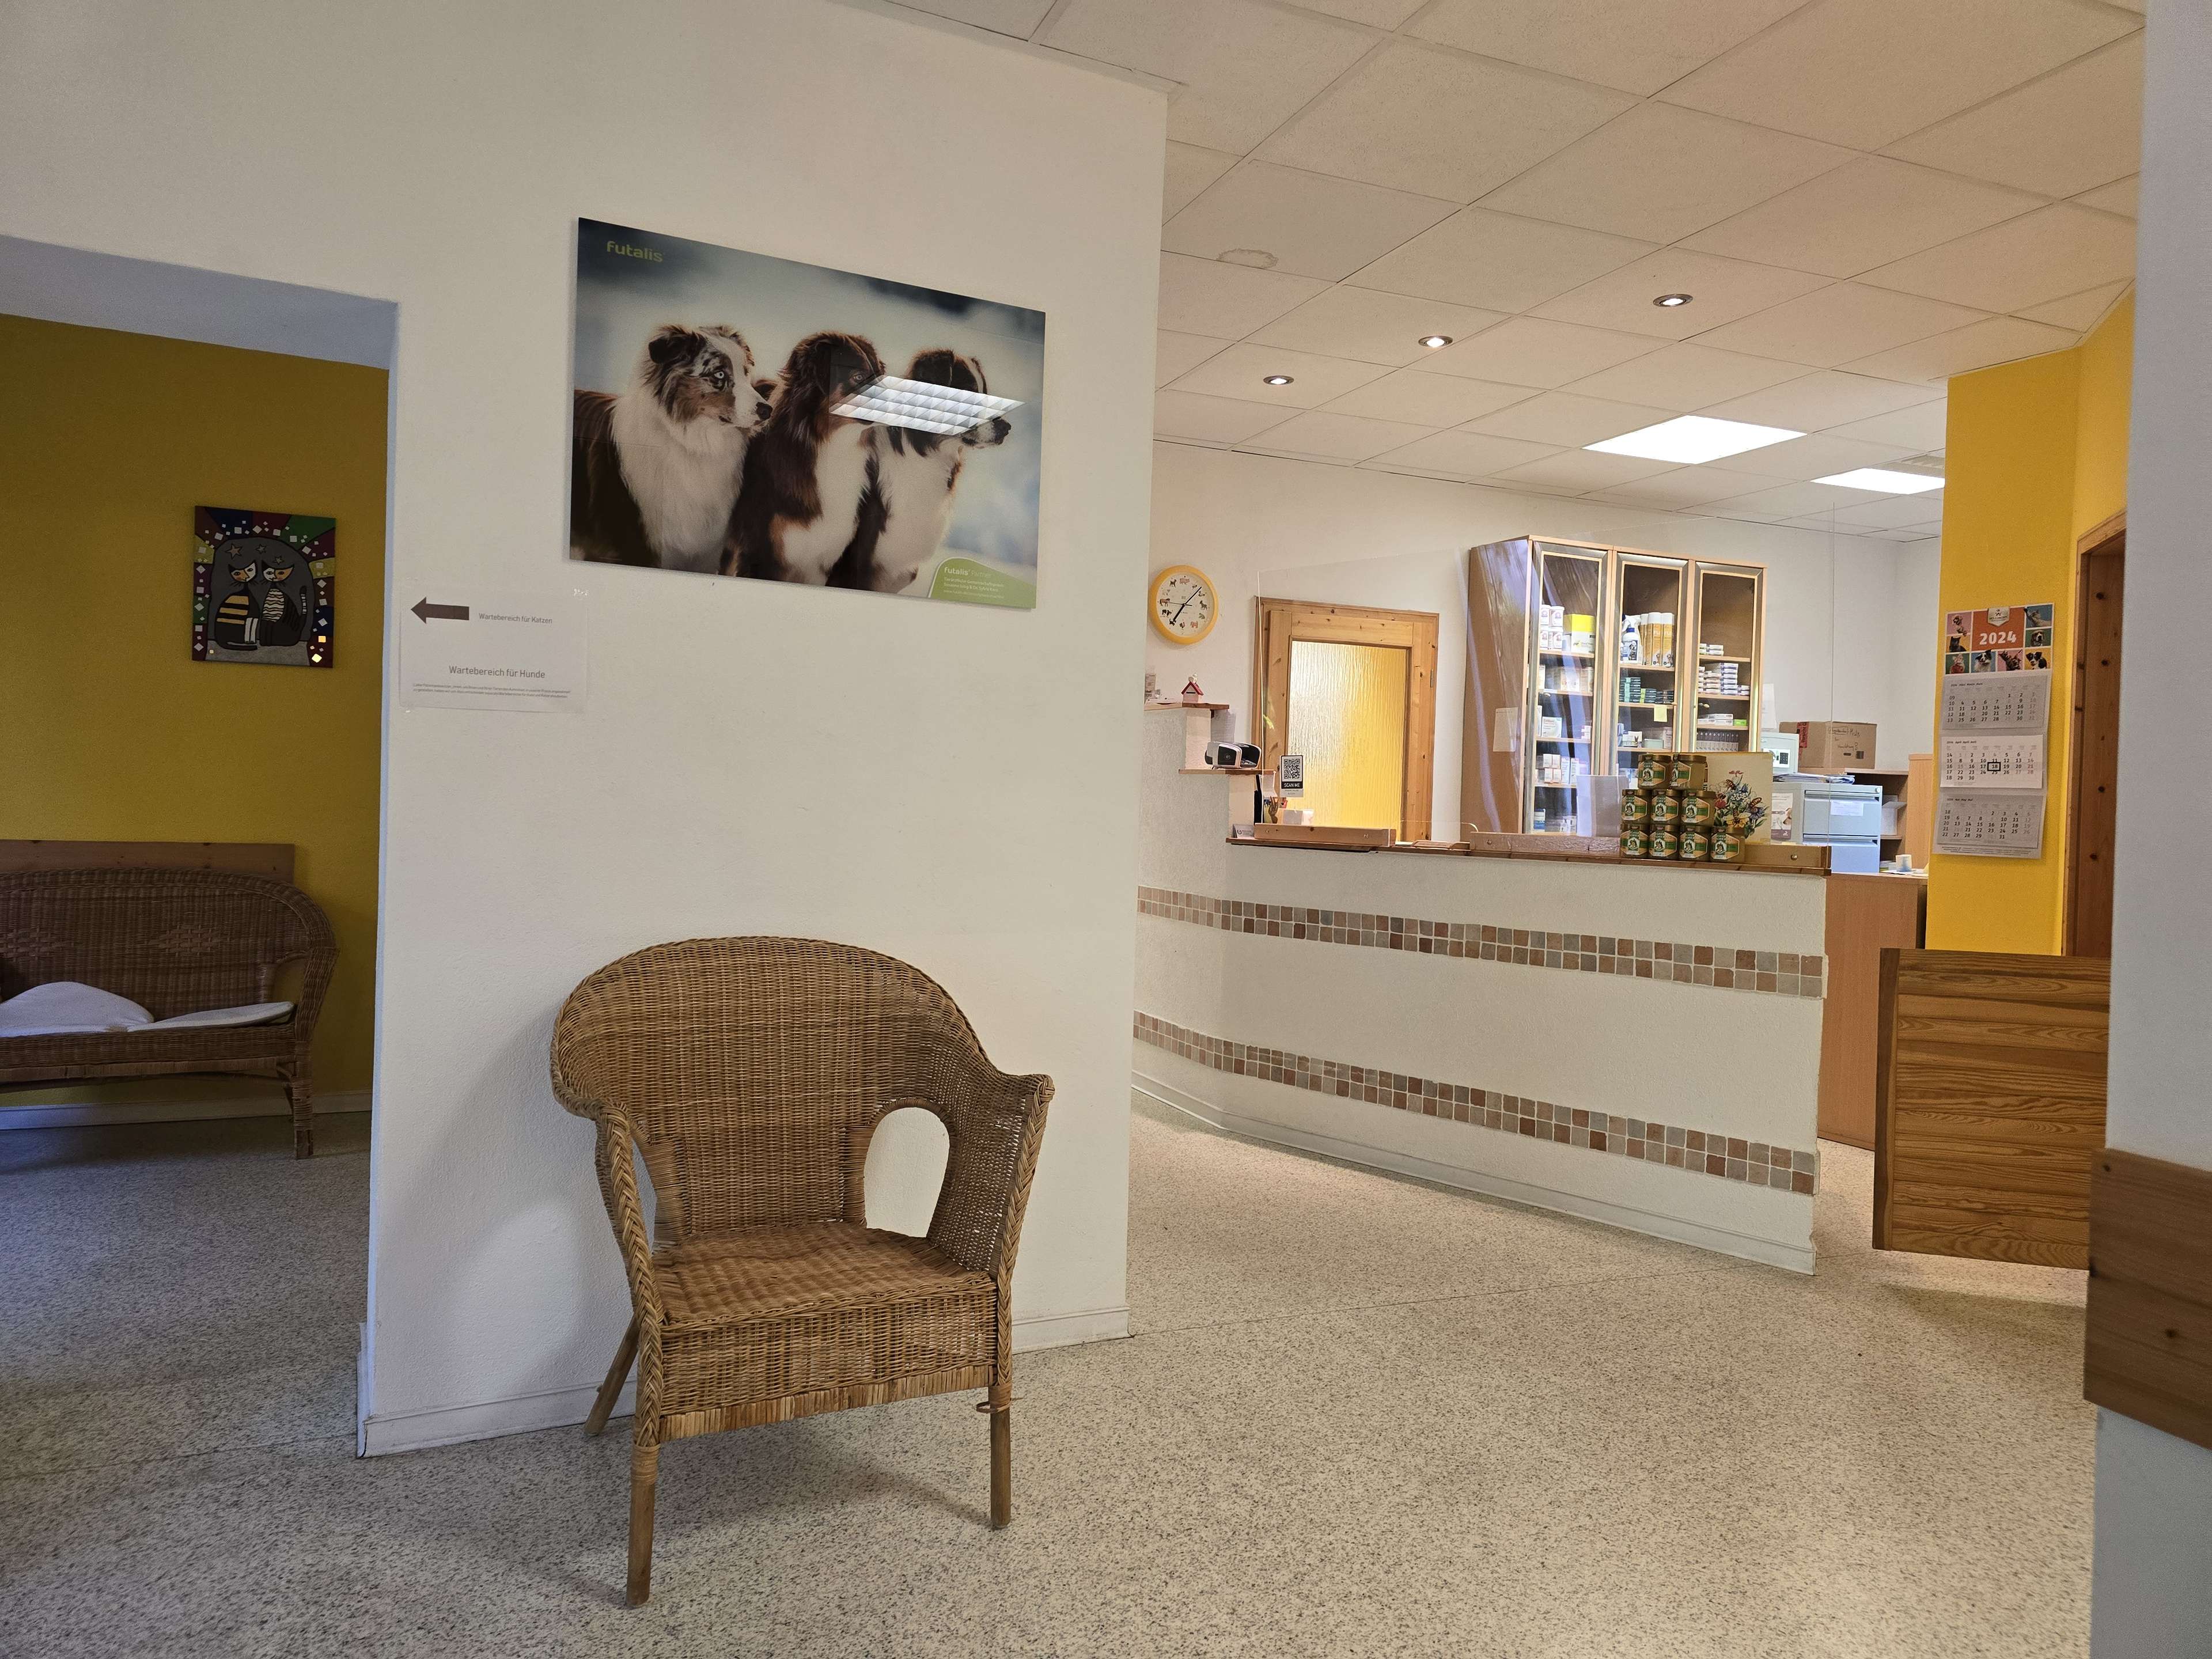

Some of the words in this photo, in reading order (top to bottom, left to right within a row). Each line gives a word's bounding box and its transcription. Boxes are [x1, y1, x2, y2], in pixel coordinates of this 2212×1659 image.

[479, 612, 520, 622] Wartebereich
[531, 616, 552, 624] Katzen
[1979, 631, 2017, 645] 2024
[449, 665, 505, 677] Wartebereich
[506, 668, 518, 677] für
[520, 669, 546, 679] Hunde
